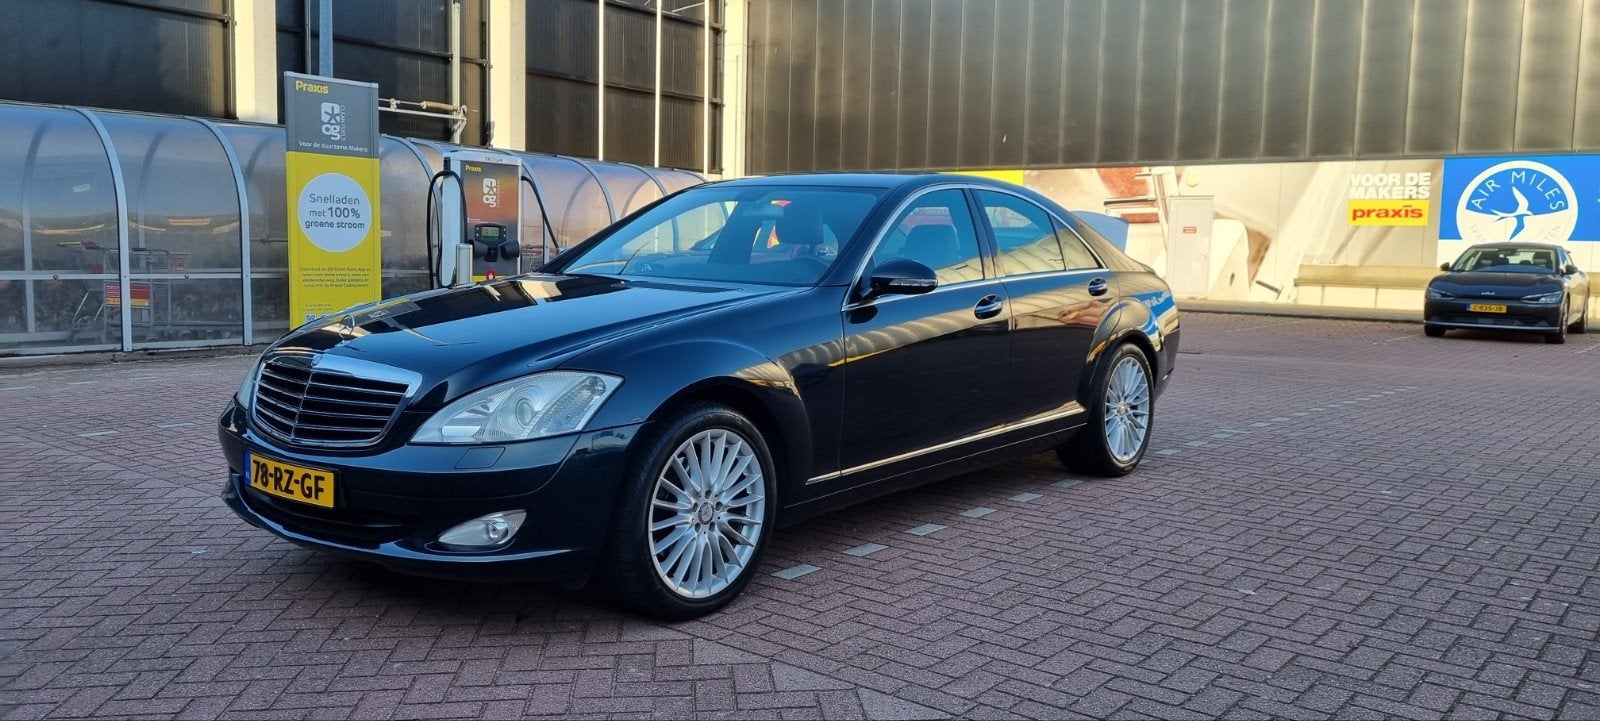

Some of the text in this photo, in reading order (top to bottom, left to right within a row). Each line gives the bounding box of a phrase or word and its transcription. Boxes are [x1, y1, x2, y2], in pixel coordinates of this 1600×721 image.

[295, 80, 329, 95] Praxis
[321, 142, 348, 151] duurzame
[1350, 171, 1432, 187] VOOR DE
[1350, 185, 1431, 200] MAKERS
[1470, 170, 1565, 211] AIR MILES
[309, 193, 360, 205] Snelladen
[309, 206, 361, 219] met 100%
[1352, 204, 1424, 221] praxis
[305, 220, 365, 229] groene stroom
[252, 460, 326, 500] 78-RZ-GF
